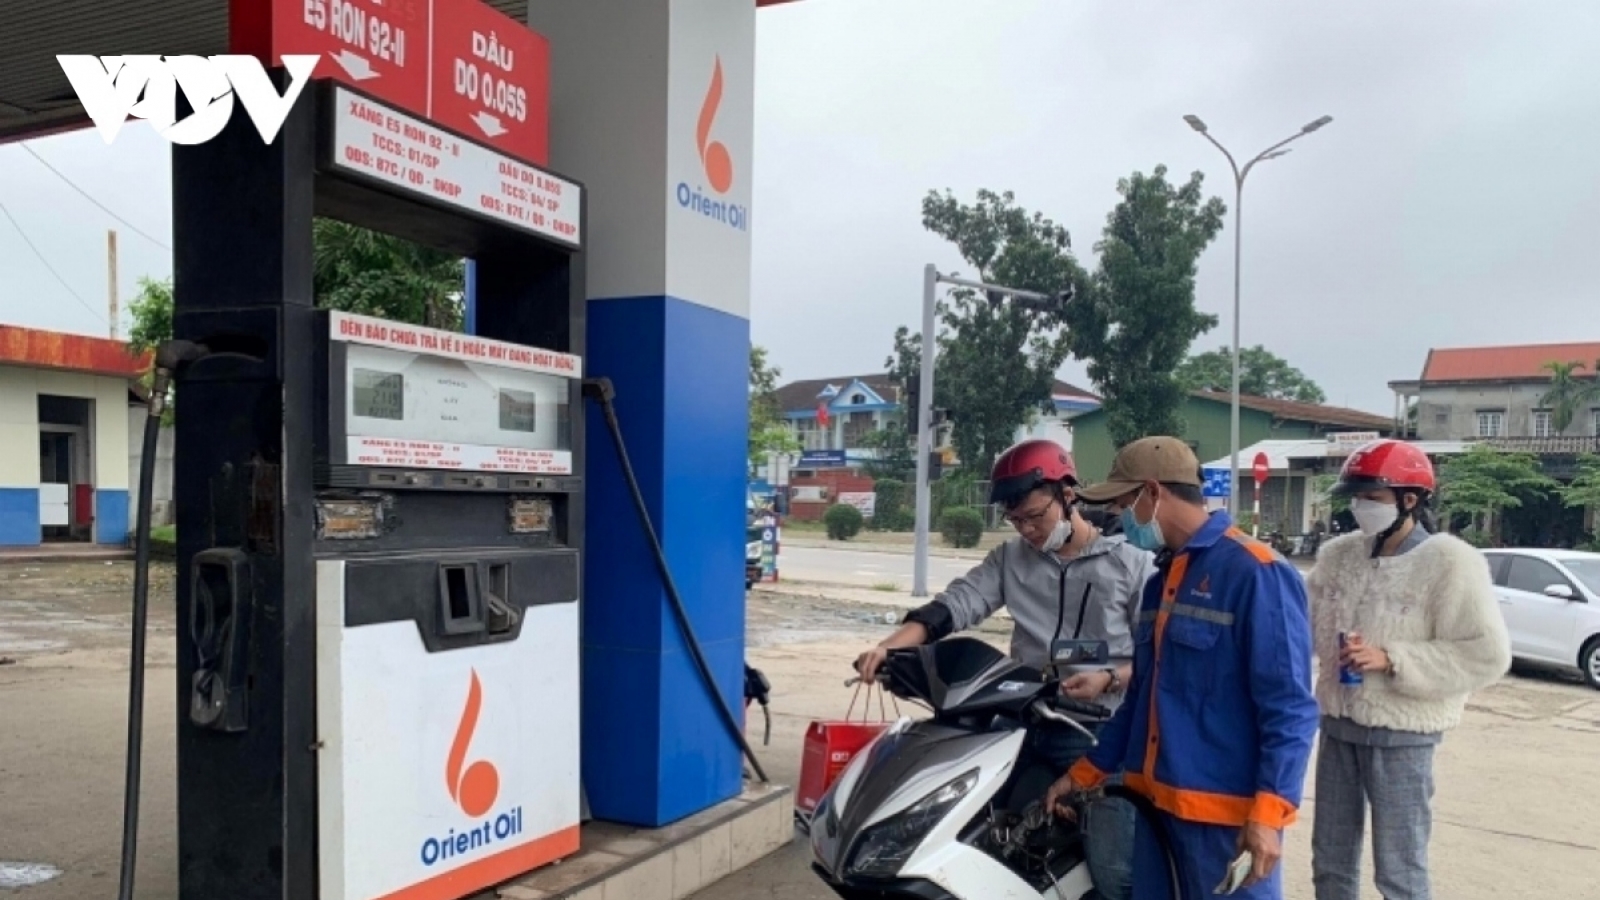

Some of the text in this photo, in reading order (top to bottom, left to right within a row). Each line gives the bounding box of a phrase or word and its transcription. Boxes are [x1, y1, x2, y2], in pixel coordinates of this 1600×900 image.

[303, 0, 326, 31] E5
[330, 0, 366, 49] RON
[472, 30, 513, 72] DẦU
[454, 57, 526, 123] DO 0.05S
[372, 131, 406, 158] TCCS:
[386, 115, 400, 133] E5
[403, 123, 426, 144] RON
[428, 133, 442, 151] 92
[677, 182, 747, 232] Orient Oil
[420, 805, 522, 867] Orient Oil
